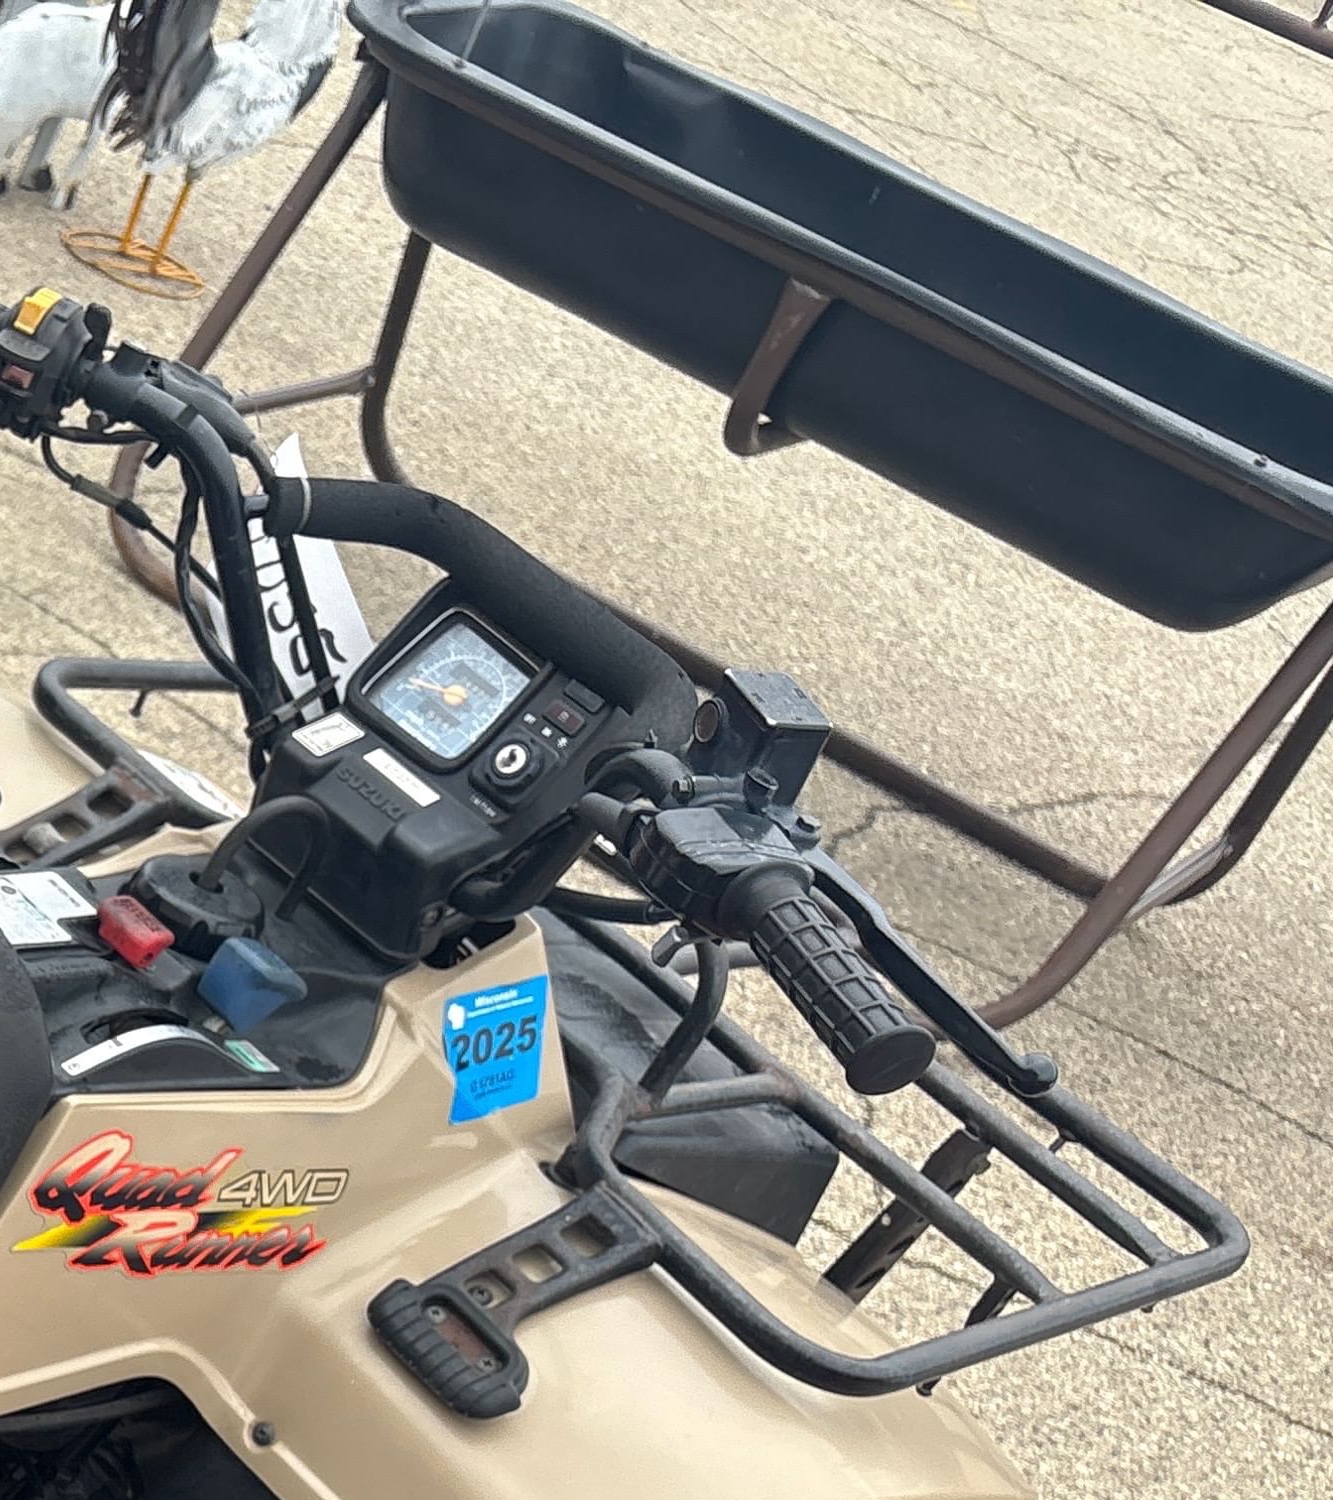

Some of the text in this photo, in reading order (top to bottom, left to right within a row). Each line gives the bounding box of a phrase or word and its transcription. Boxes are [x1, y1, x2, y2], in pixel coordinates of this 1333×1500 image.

[336, 766, 406, 822] SUZUKI
[451, 1014, 537, 1073] 2025
[30, 1129, 349, 1226] Quad 4WD
[66, 1209, 329, 1281] Runner
